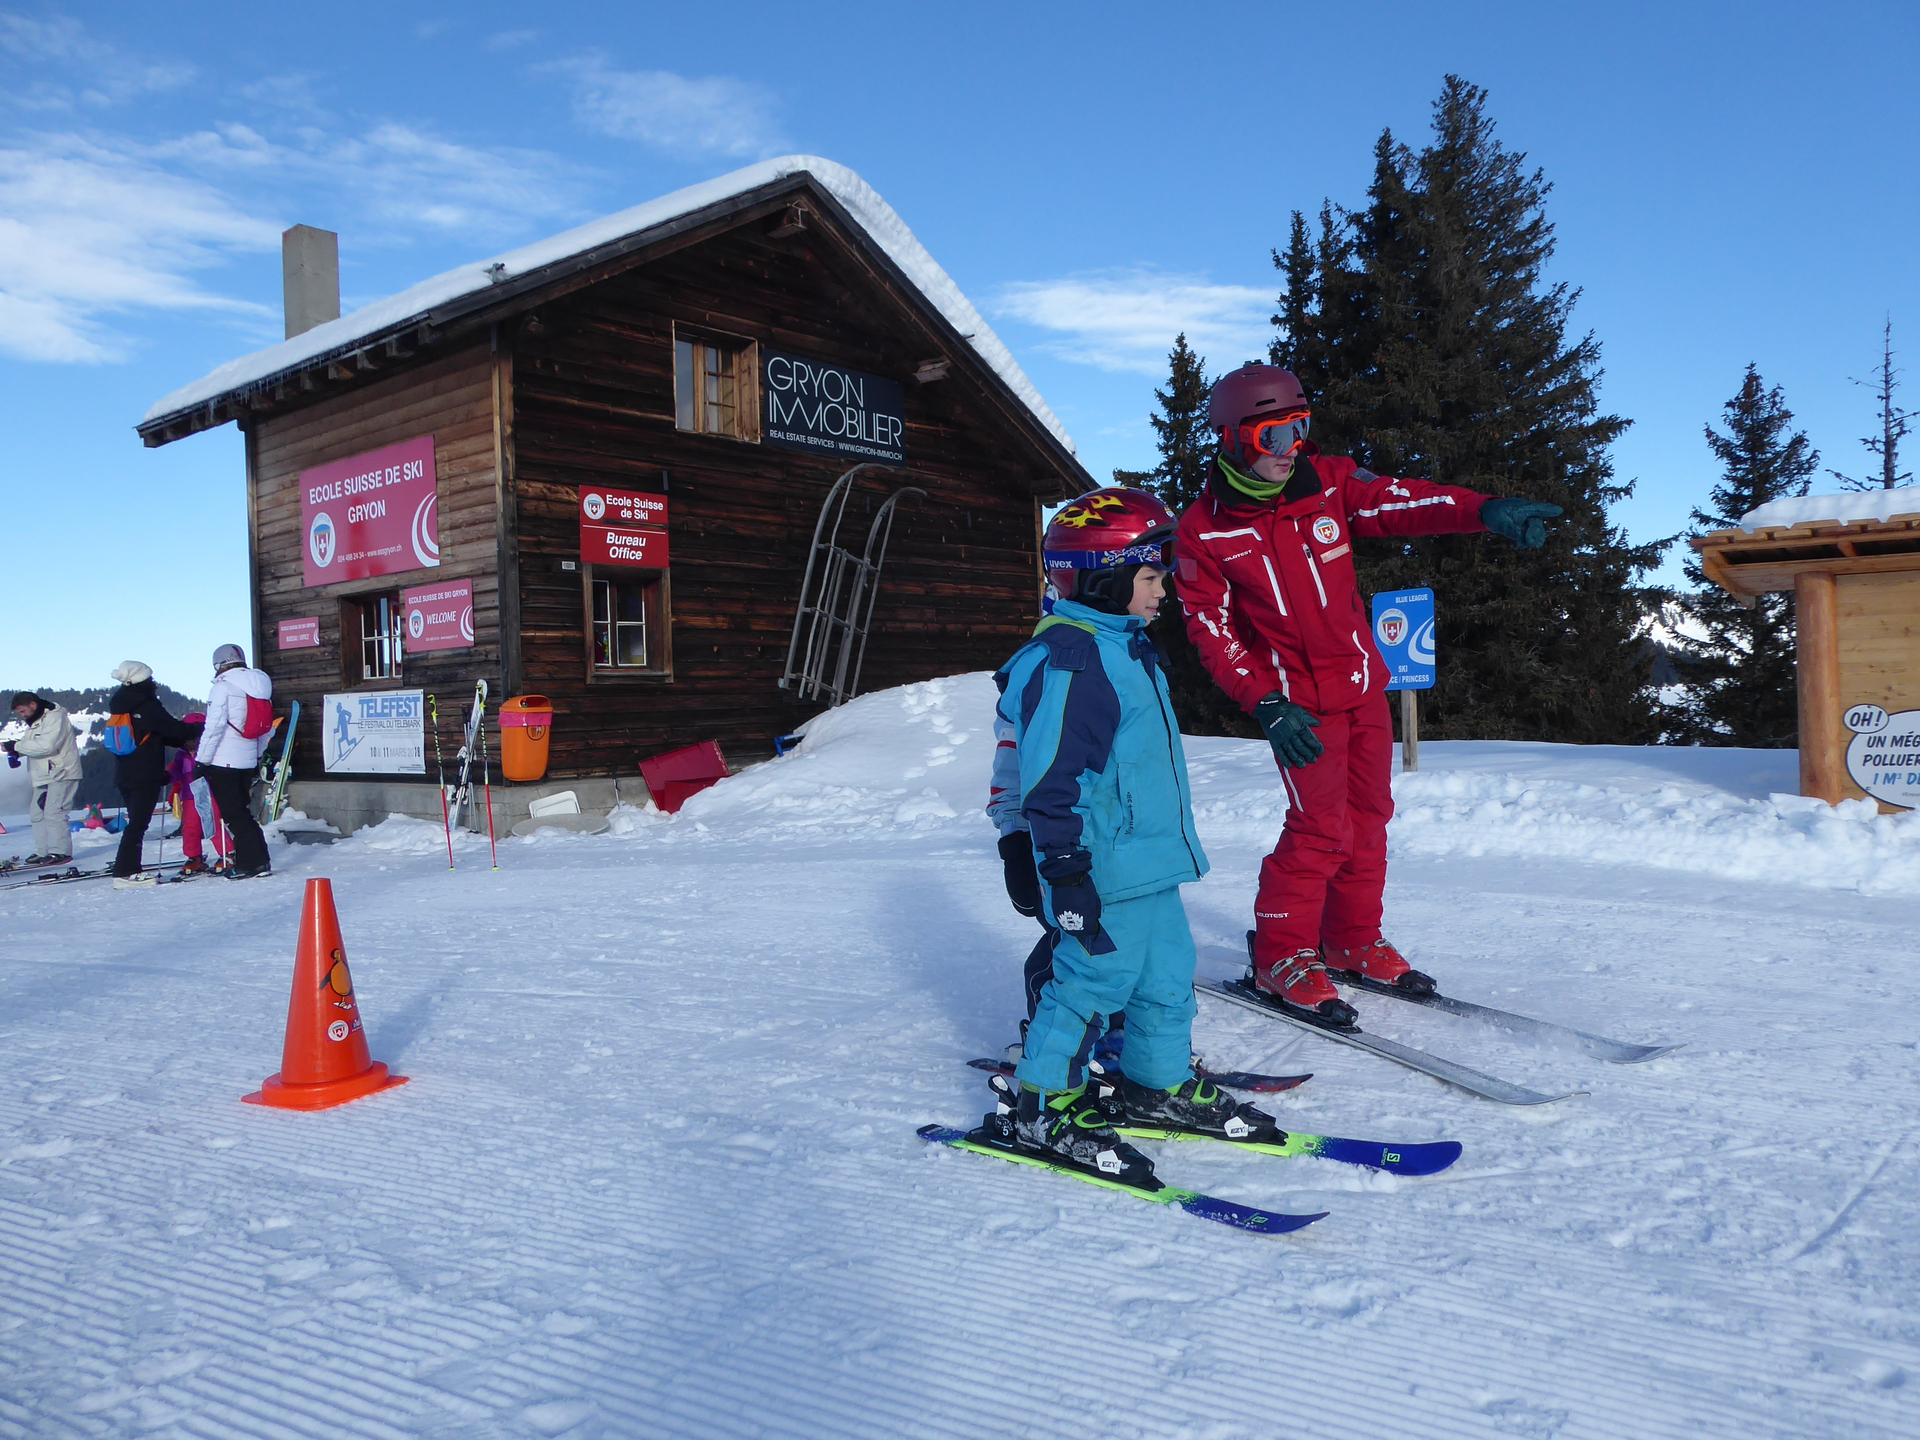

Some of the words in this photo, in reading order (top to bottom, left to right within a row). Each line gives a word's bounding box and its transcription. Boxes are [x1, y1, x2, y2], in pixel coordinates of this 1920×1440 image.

[768, 357, 864, 408] GRYON
[769, 390, 902, 448] IMMOBILIER
[770, 429, 785, 440] REAL
[786, 432, 806, 443] ESTATE
[807, 436, 835, 449] SERVICES
[838, 442, 902, 461] WWW.GRYON-IMMO.CH
[309, 481, 342, 505] ECOLE
[344, 470, 382, 499] SUISSE
[385, 466, 400, 486] DE
[403, 459, 423, 481] SKI
[606, 494, 632, 507] Ecole
[633, 497, 664, 511] Suisse
[348, 499, 386, 524] GRYON
[620, 508, 632, 519] de
[634, 509, 649, 520] Ski
[606, 532, 646, 547] Bureau
[609, 546, 643, 560] Office
[1049, 559, 1073, 569] uvex
[408, 595, 422, 604] ECOLE
[422, 593, 437, 602] SUISSE
[438, 592, 444, 600] DE
[444, 591, 452, 599] SKI
[452, 588, 468, 598] GRYON
[1395, 595, 1408, 604] BLUE
[1408, 594, 1428, 602] LEAGUE
[426, 610, 457, 625] WELCOME
[1398, 665, 1408, 673] SKI
[1401, 674, 1430, 683] PRINCESS
[358, 696, 421, 719] TELEFEST
[364, 720, 386, 729] FESTIVAL
[386, 720, 394, 728] DU
[394, 719, 421, 728] TELEMARK
[1866, 735, 1887, 748] UN
[1890, 731, 1920, 748] MÉG
[383, 746, 389, 757] 11
[1109, 1105, 1116, 1115] 5
[1002, 1125, 1009, 1136] 5
